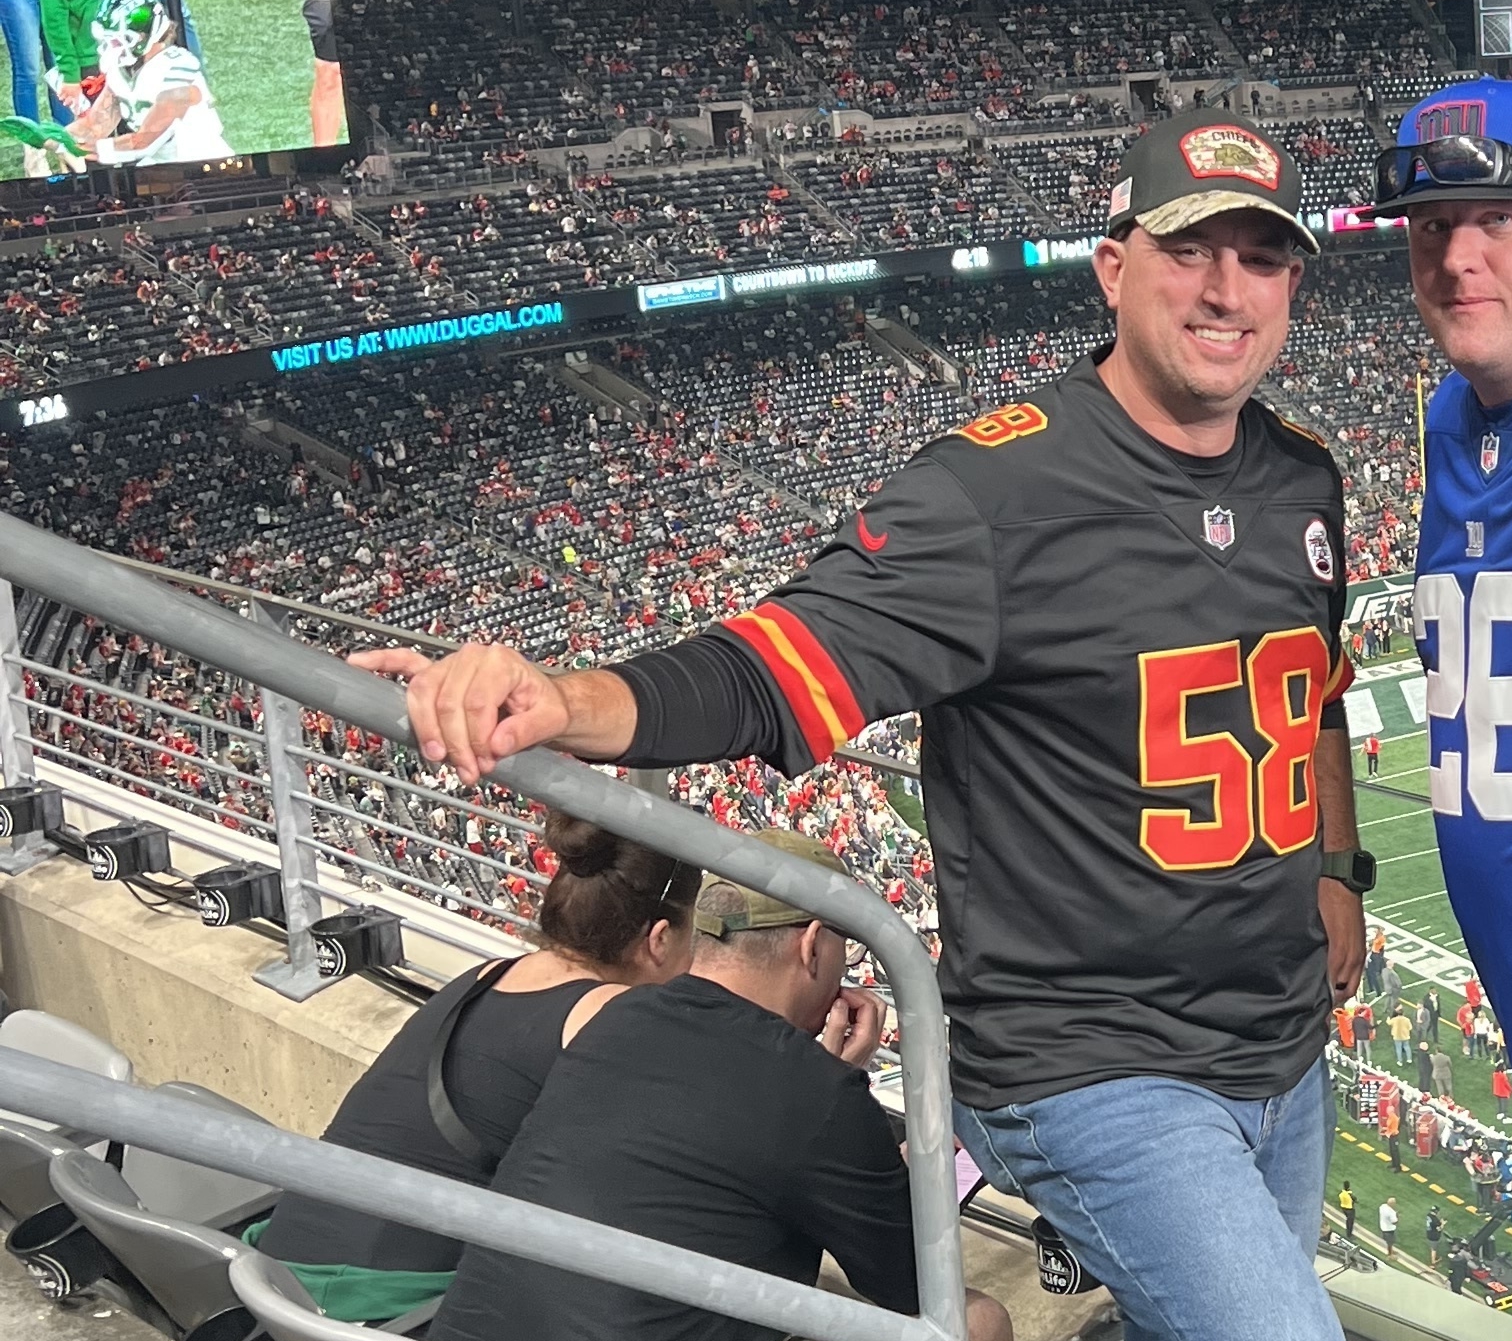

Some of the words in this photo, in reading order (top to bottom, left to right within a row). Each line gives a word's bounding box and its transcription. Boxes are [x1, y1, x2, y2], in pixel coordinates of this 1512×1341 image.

[1211, 129, 1262, 154] CHIEFS
[806, 263, 825, 283] TO
[826, 258, 878, 283] KICKOFF
[271, 341, 323, 373] VISIT
[325, 336, 354, 364] US
[356, 330, 384, 358] AT:
[383, 302, 564, 354] WWW.DUGGAL.COM
[1137, 625, 1330, 871] 58
